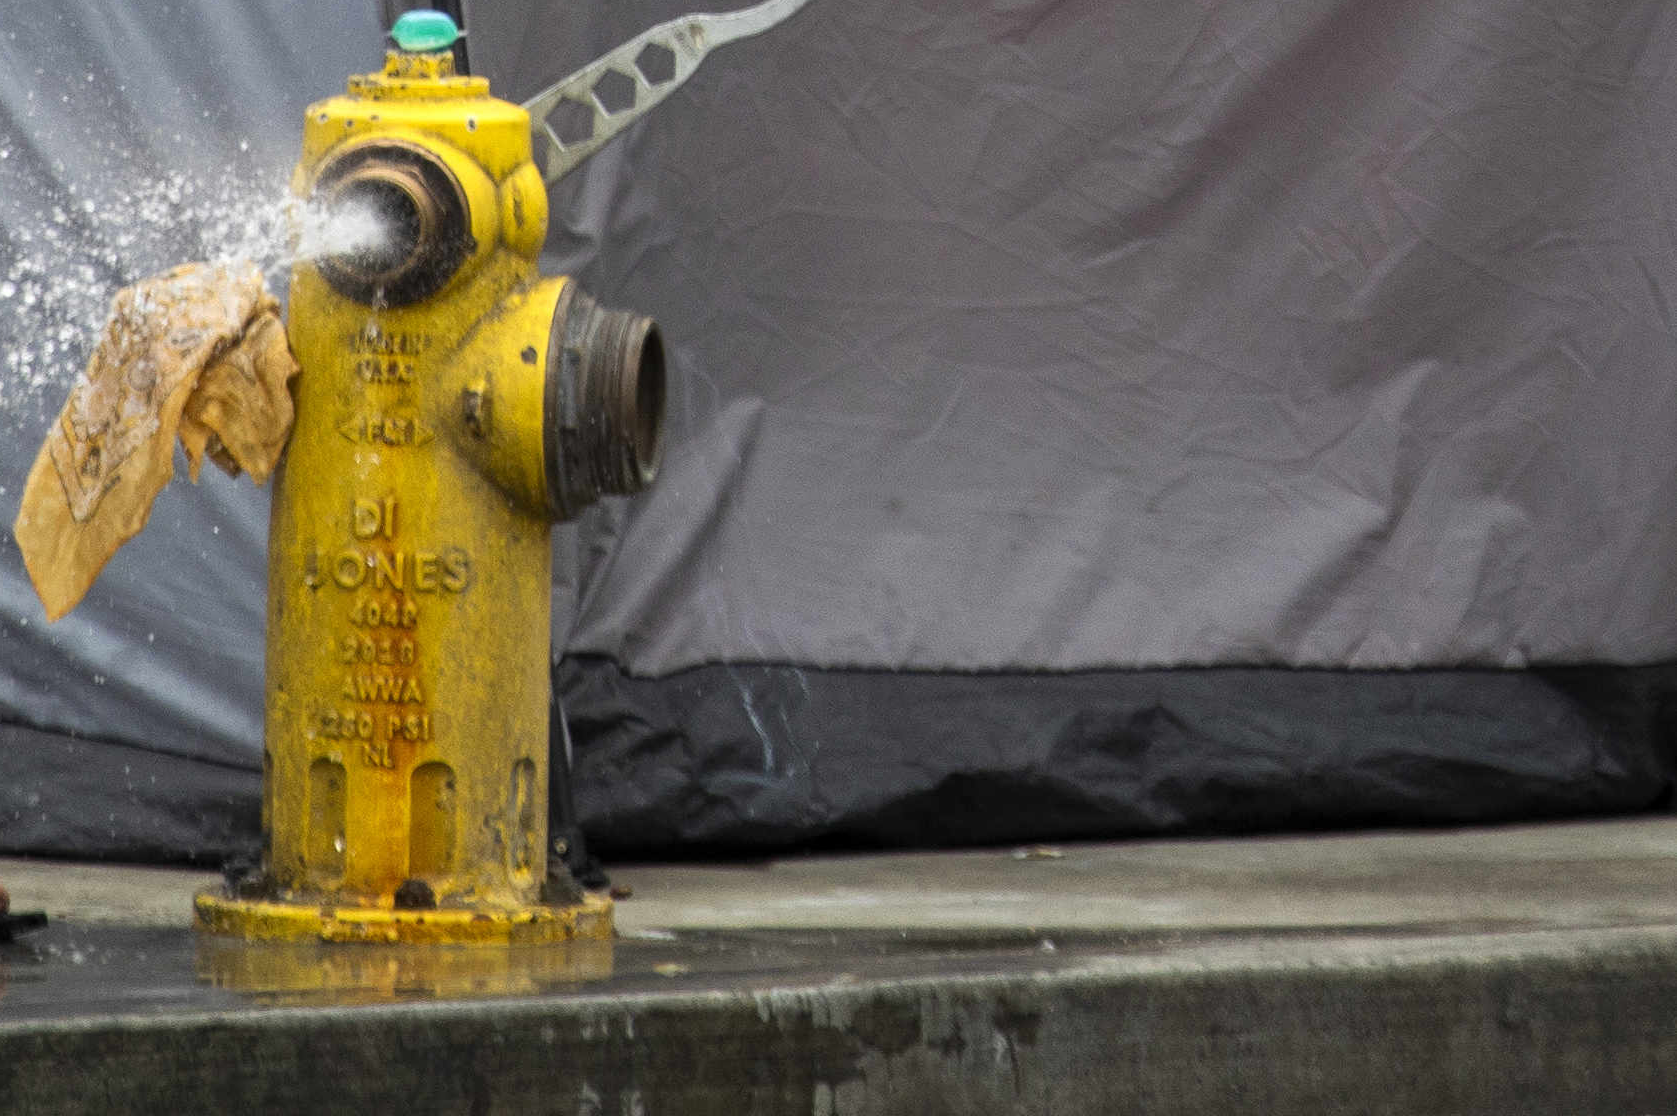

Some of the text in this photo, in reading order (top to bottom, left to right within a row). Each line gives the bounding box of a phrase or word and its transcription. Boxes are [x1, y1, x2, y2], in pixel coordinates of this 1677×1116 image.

[304, 546, 476, 594] JONES
[341, 674, 425, 704] AWWA
[387, 712, 433, 744] PSI
